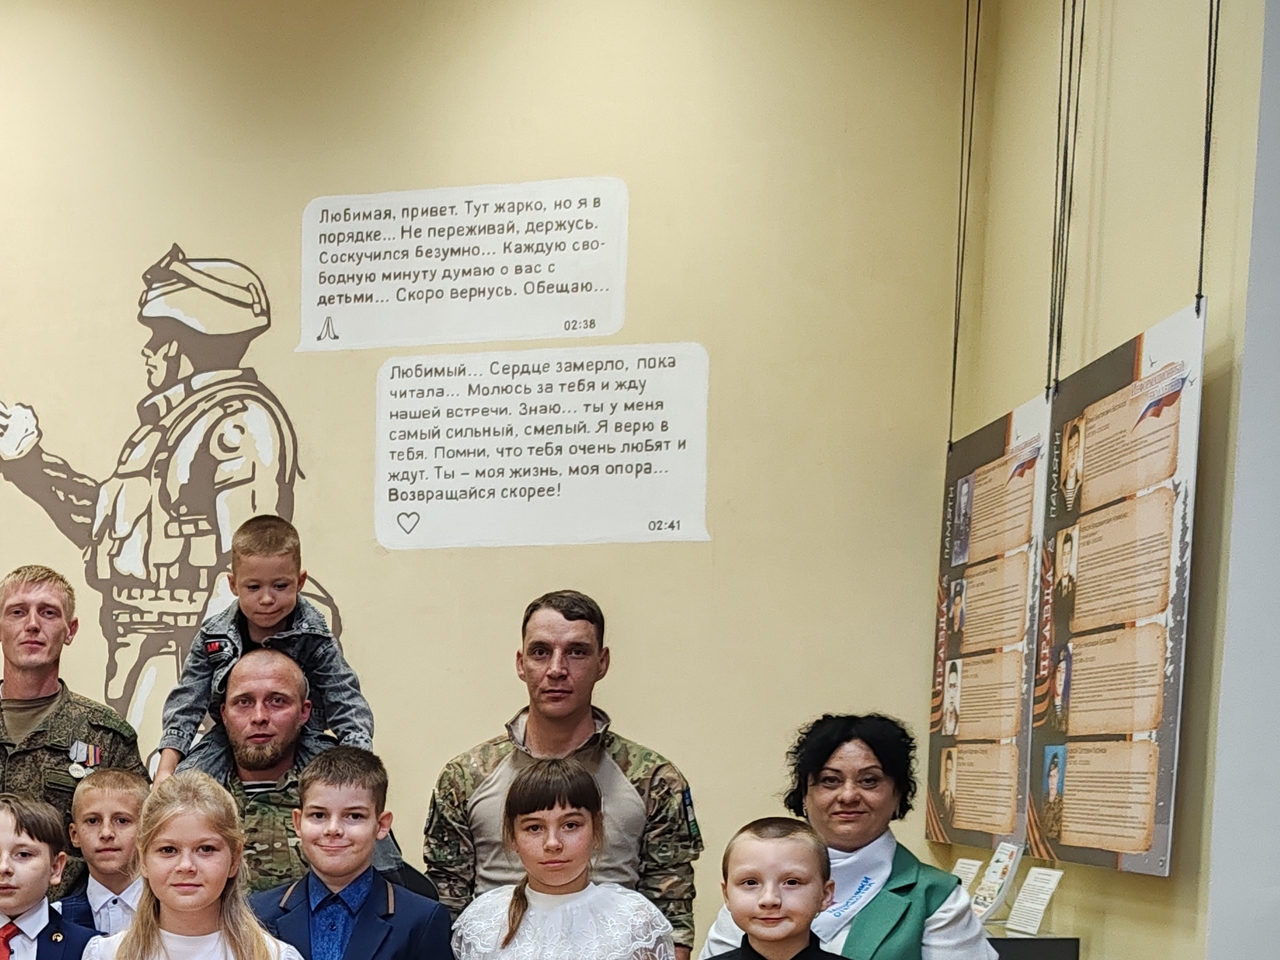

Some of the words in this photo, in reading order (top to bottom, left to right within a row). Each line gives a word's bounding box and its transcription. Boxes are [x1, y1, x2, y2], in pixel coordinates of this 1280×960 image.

[319, 208, 396, 223] Любимая,
[402, 205, 458, 221] привет.
[464, 200, 489, 218] Тут
[494, 201, 546, 215] жарко,
[554, 199, 572, 210] но
[577, 198, 587, 209] я
[593, 197, 601, 208] в
[319, 230, 395, 246] порядке...
[401, 225, 422, 240] Не
[428, 220, 520, 240] переживай,
[525, 219, 598, 235] держусь.
[319, 250, 409, 266] Соскучился
[503, 241, 566, 256] Каждую
[572, 240, 605, 251] сво-
[382, 269, 437, 283] минуту
[441, 267, 495, 281] думаю
[500, 266, 508, 275] о
[515, 264, 541, 275] вас
[548, 263, 555, 273] с
[317, 293, 389, 307] детьми...
[396, 287, 444, 304] Скоро
[450, 286, 517, 302] вернусь.
[524, 281, 609, 295] Обещаю...
[564, 319, 596, 331] 02:38
[390, 363, 482, 379] Любимый...
[490, 361, 550, 380] Сердце
[556, 360, 628, 374] замерло,
[637, 356, 676, 369] пока
[390, 388, 459, 398] читала...
[468, 383, 532, 396] Молюсь
[537, 383, 553, 393] за
[559, 379, 595, 392] тебя
[601, 381, 609, 390] и
[614, 379, 646, 395] жду
[390, 406, 440, 419] нашей
[446, 407, 512, 418] встречи.
[519, 402, 577, 415] Знаю...
[583, 403, 604, 412] ты
[609, 402, 618, 415] у
[624, 401, 663, 411] меня
[389, 426, 440, 441] самый
[446, 424, 518, 439] сильный,
[524, 421, 590, 435] смелый.
[595, 420, 608, 433] Я
[615, 422, 654, 436] верю
[661, 420, 669, 432] в
[389, 447, 427, 461] тебя.
[434, 446, 489, 459] Помни,
[496, 447, 522, 457] что
[527, 442, 562, 456] тебя
[569, 444, 616, 455] очень
[678, 439, 686, 450] и
[388, 470, 428, 485] ждут.
[434, 466, 454, 479] Ты
[475, 468, 505, 478] моя
[509, 467, 562, 478] жизнь,
[569, 465, 599, 476] моя
[605, 462, 668, 479] опора...
[389, 486, 495, 504] Возвращайся
[501, 483, 560, 502] скорее!
[648, 520, 680, 531] 02:41
[1039, 569, 1055, 677] ПРАВДА
[1049, 431, 1062, 518] ПАМЯТИ
[935, 603, 948, 692] ПРАВДА
[943, 487, 955, 559] ПАМЯТИ
